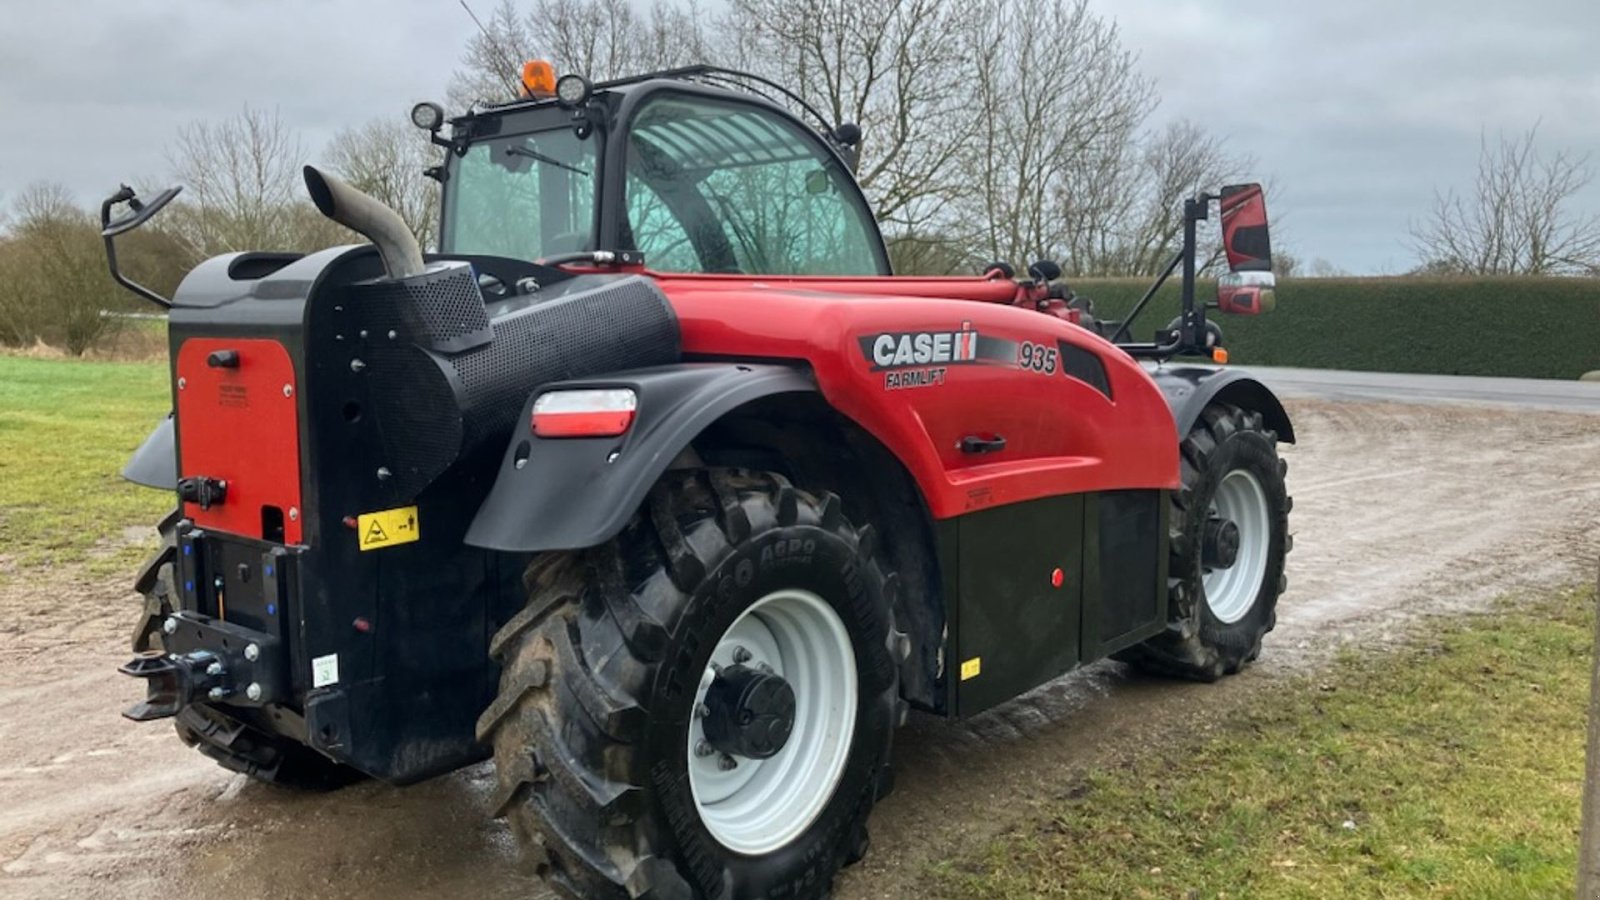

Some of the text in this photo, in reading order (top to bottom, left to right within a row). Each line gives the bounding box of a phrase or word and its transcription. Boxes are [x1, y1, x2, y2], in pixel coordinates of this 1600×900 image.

[873, 333, 951, 366] CASE
[1019, 341, 1056, 375] 935
[885, 368, 946, 391] FARMLIFT
